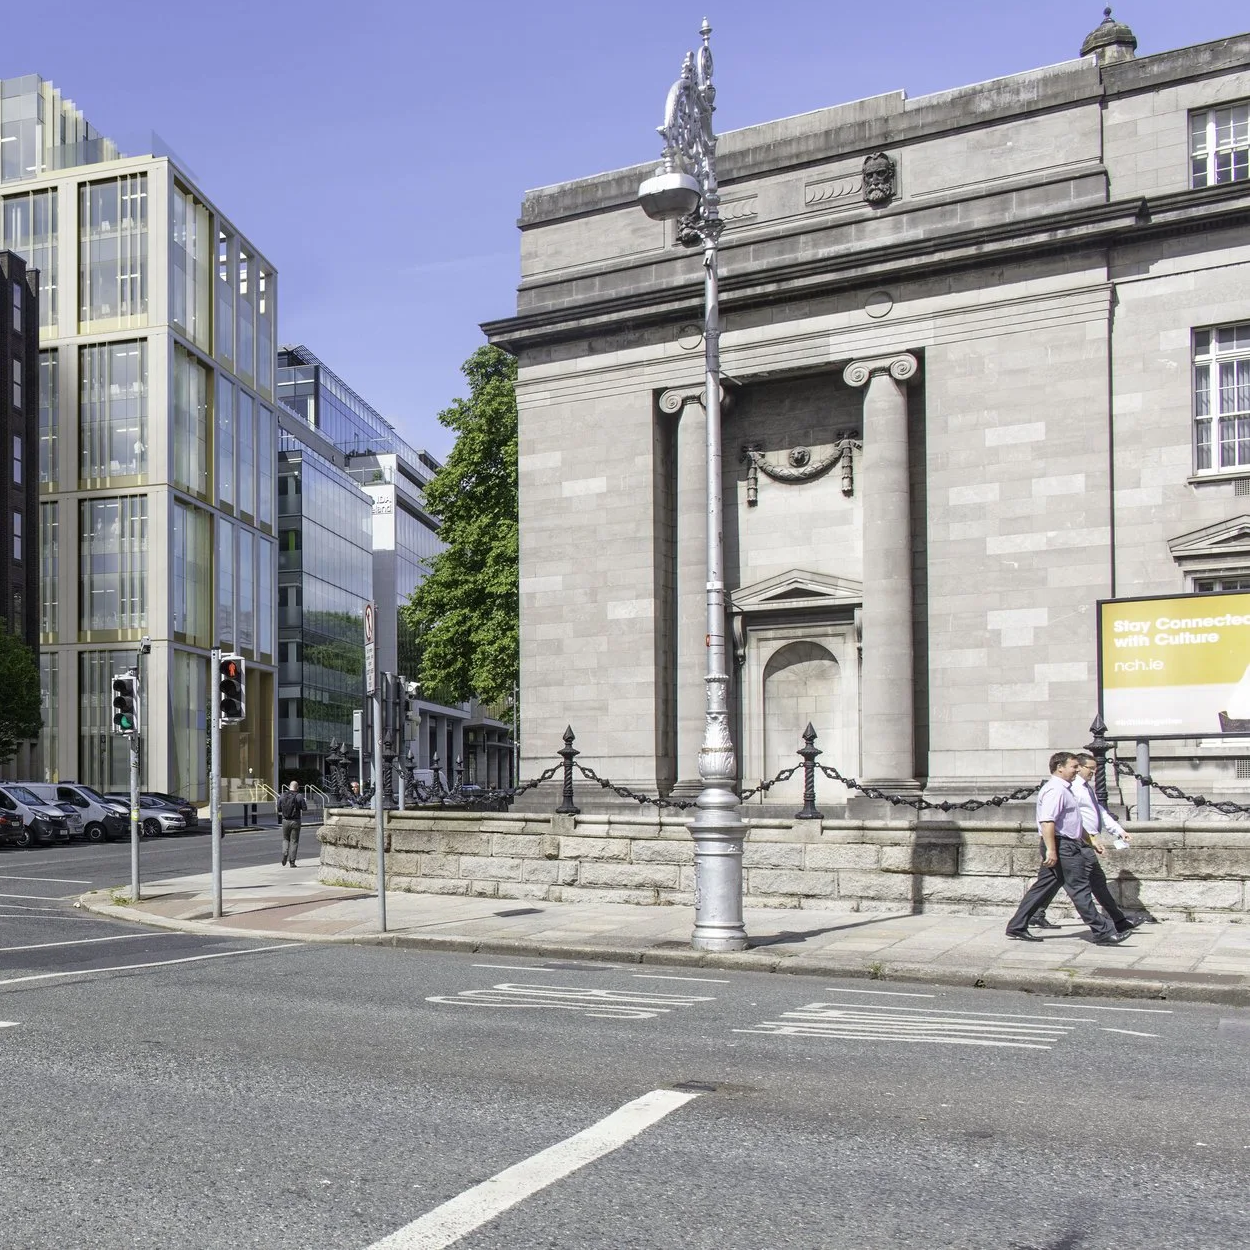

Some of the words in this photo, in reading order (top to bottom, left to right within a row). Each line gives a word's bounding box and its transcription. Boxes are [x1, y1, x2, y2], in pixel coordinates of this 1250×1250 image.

[377, 496, 391, 504] IDA
[1114, 620, 1151, 633] Stay
[1114, 635, 1149, 647] with
[1154, 632, 1219, 646] Culture
[1114, 659, 1164, 671] nch.ie
[425, 983, 717, 1019] BUS
